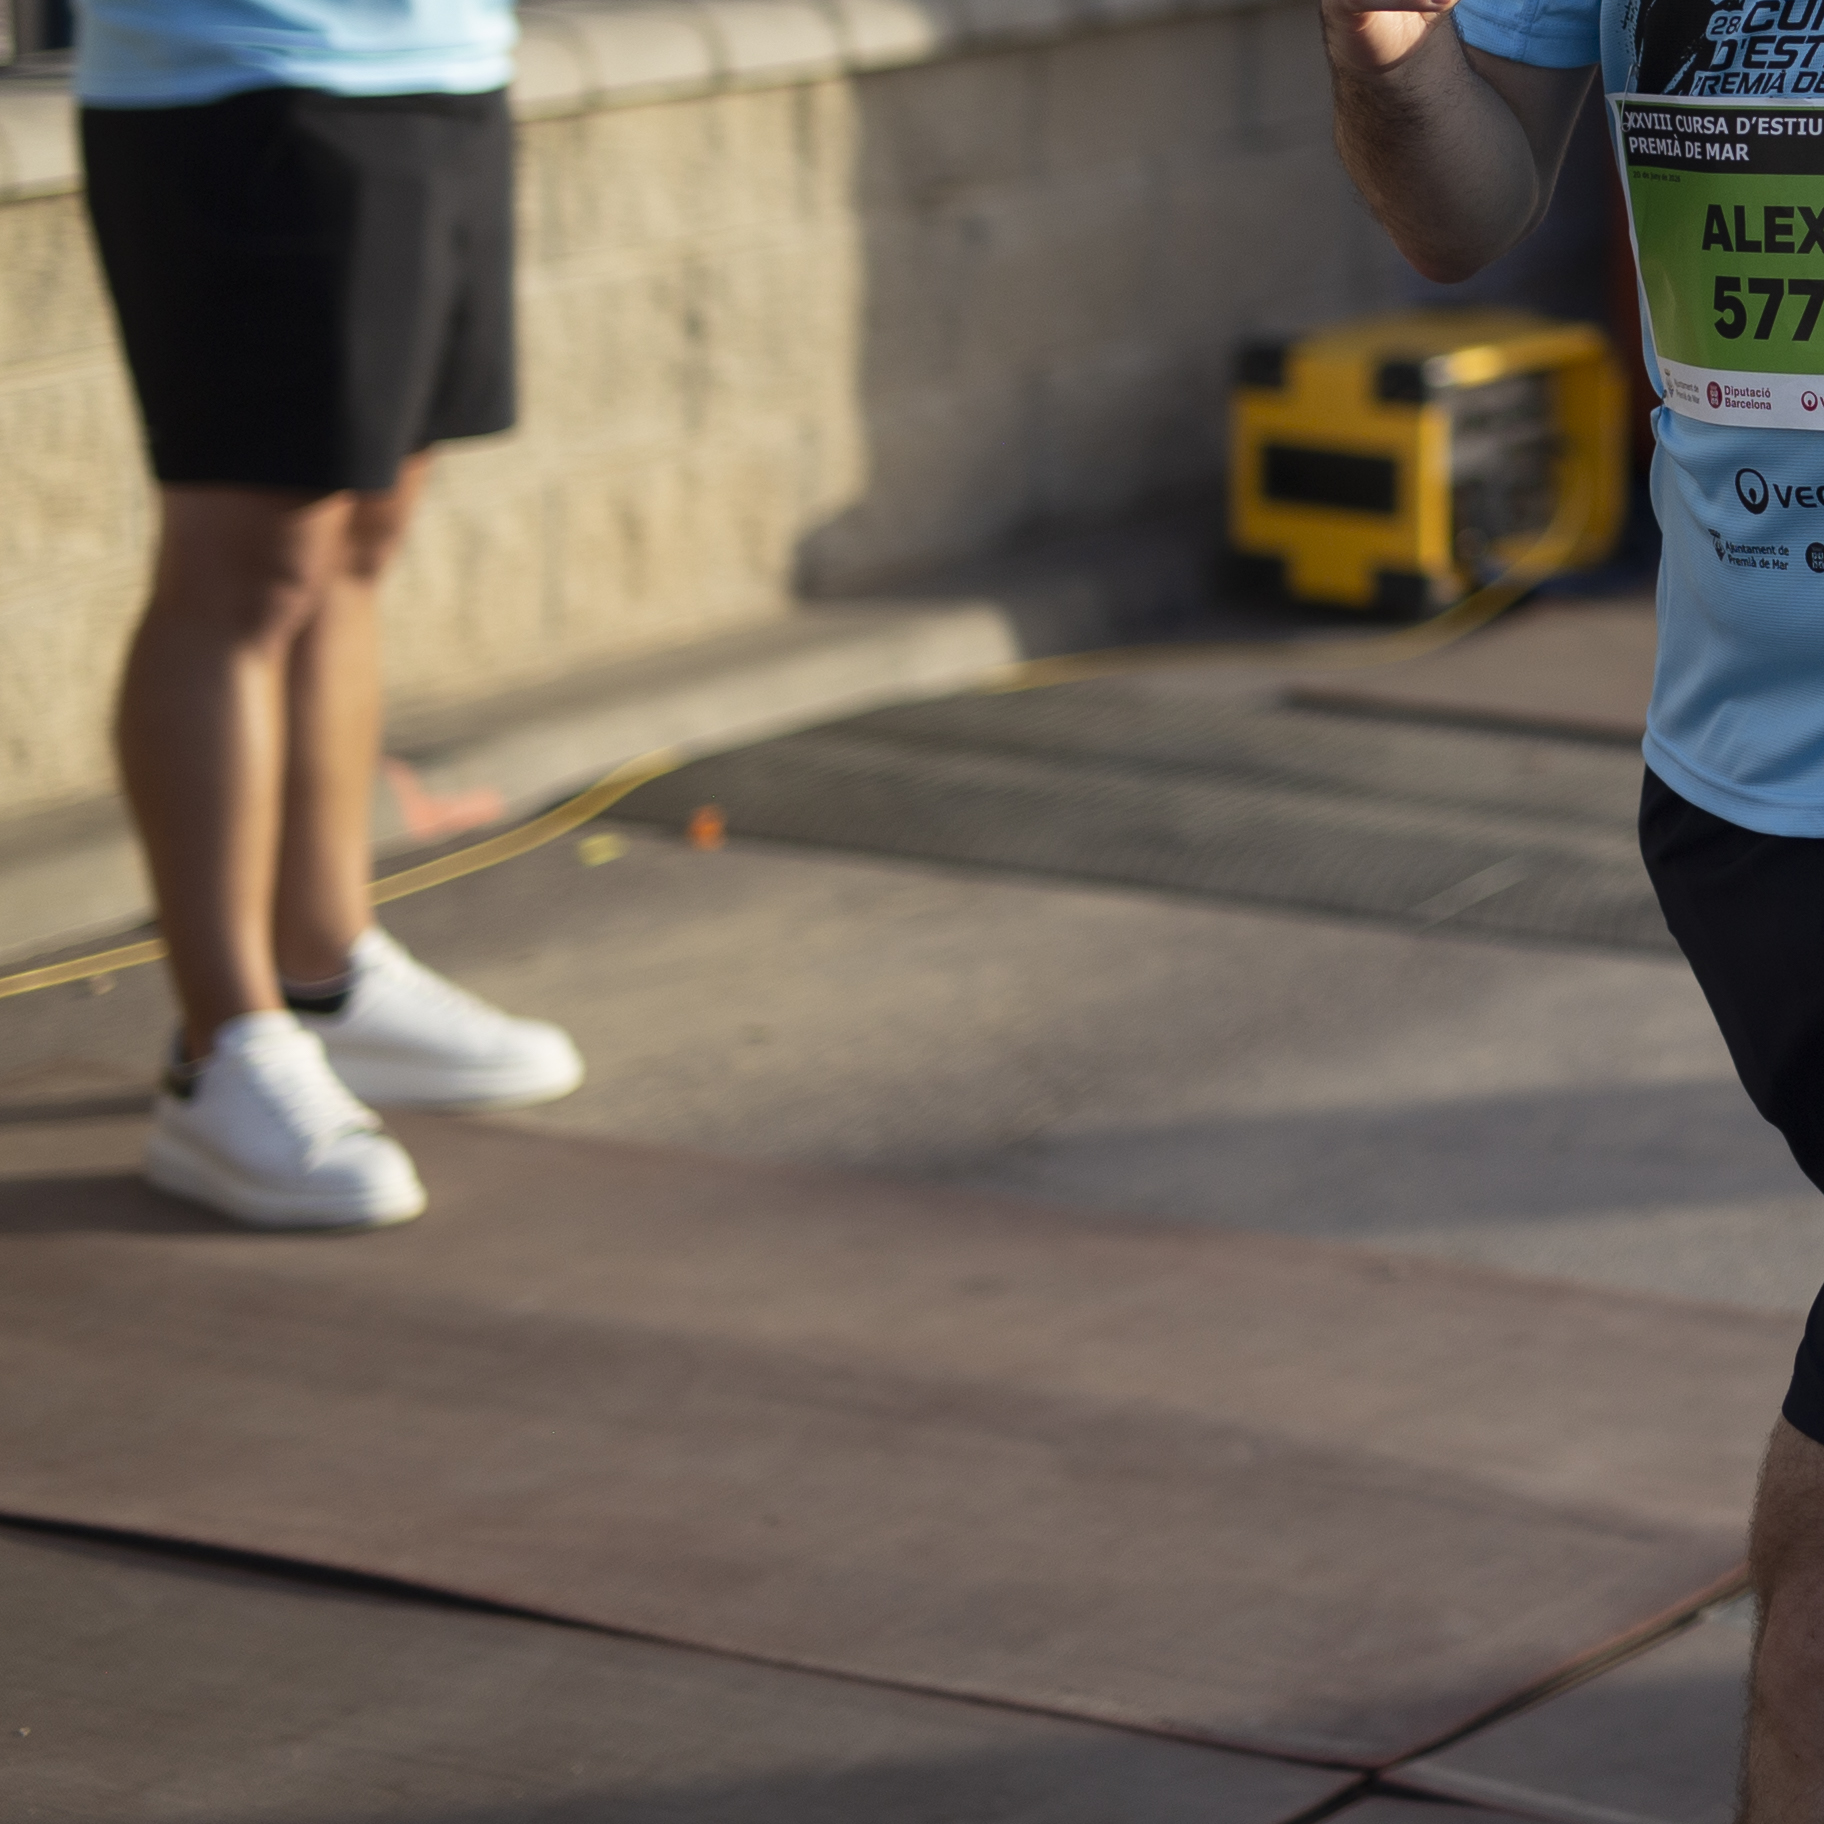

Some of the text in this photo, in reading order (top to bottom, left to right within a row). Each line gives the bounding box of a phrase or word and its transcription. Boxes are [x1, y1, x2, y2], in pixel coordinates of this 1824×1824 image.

[1625, 112, 1823, 136] XXVIII CURSA D'ESTIU
[1629, 134, 1750, 161] PREMIÀ DE MAR
[1724, 385, 1771, 399] Diputació
[1725, 397, 1772, 411] Barcelona
[1725, 542, 1790, 556] Ajuntament de
[1759, 557, 1770, 569] de
[1772, 559, 1789, 571] Mar
